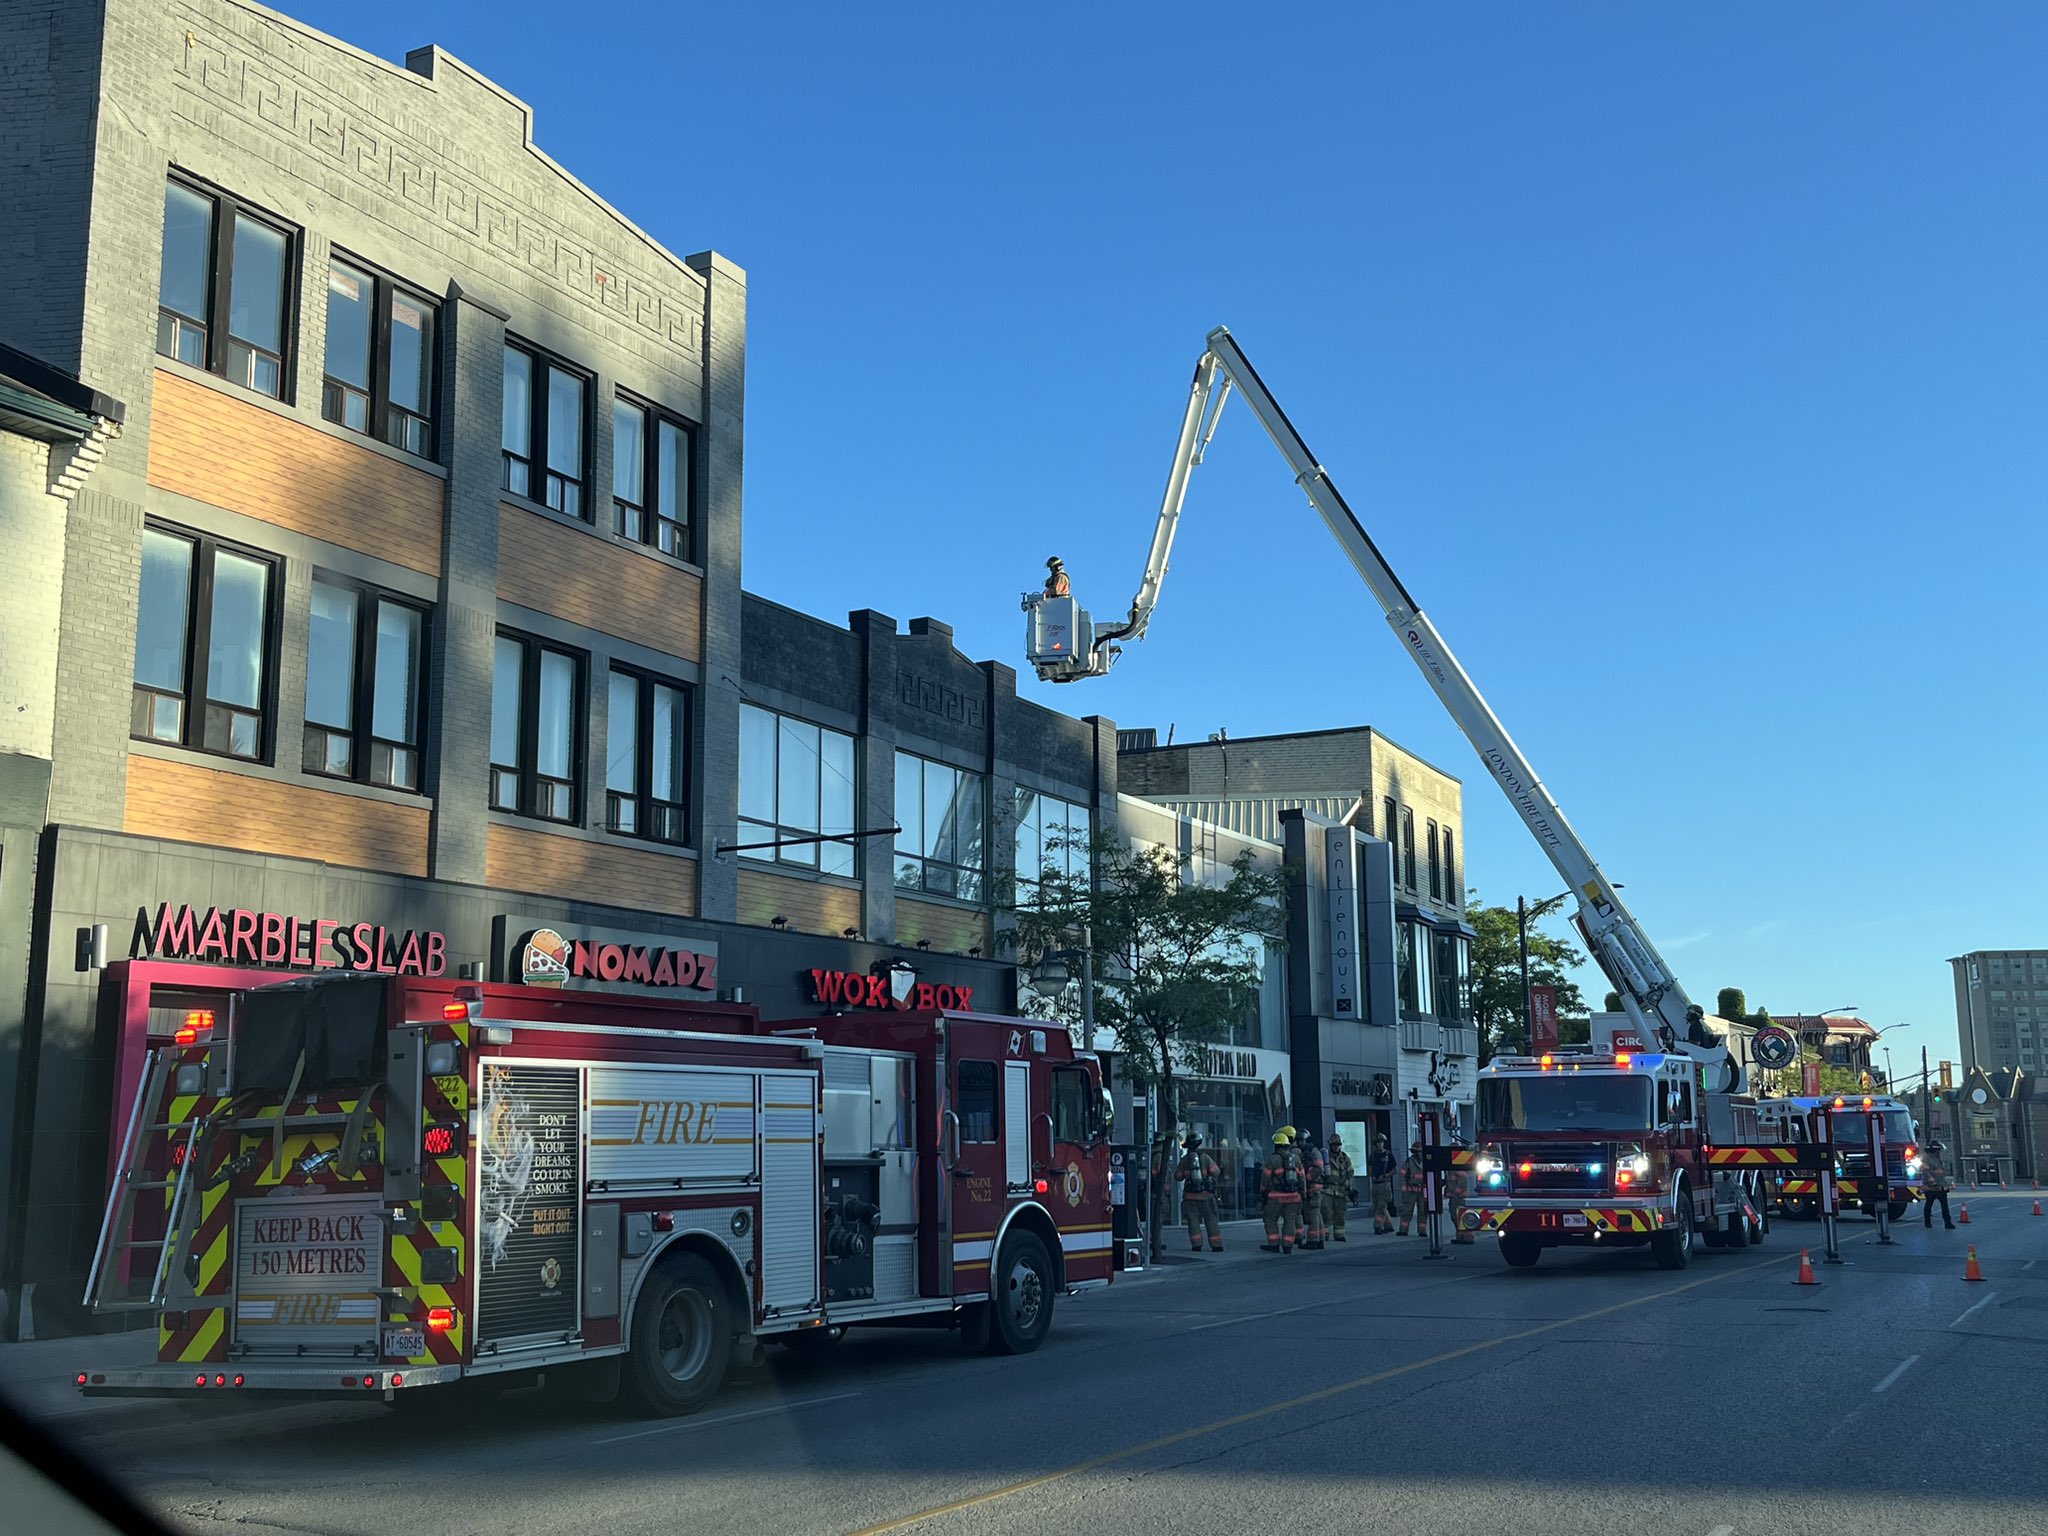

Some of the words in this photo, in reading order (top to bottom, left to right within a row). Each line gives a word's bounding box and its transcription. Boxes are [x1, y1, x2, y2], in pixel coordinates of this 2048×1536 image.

[1486, 748, 1524, 793] LONDON
[1518, 794, 1542, 819] FIRE
[1535, 819, 1562, 849] DEPT.
[153, 901, 339, 967] MARBLE
[353, 921, 447, 977] SLAB
[573, 938, 718, 991] NOMADZ
[811, 968, 889, 1010] WOK
[916, 982, 974, 1012] BOX
[1534, 993, 1544, 1040] RICHMOND
[1541, 994, 1551, 1017] ROW
[1616, 1037, 1643, 1047] CIRC
[545, 1128, 562, 1139] LET
[632, 1101, 718, 1145] FIRE
[539, 1142, 565, 1153] YOUR
[534, 1155, 571, 1167] DREAMS
[532, 1169, 548, 1181] GO
[549, 1169, 561, 1181] UP
[561, 1168, 572, 1180] IN
[966, 1177, 991, 1189] ENGINE
[533, 1209, 547, 1221] PUT
[547, 1209, 556, 1220] IT
[1537, 1213, 1557, 1227] T1
[253, 1217, 302, 1244] KEEP
[306, 1215, 365, 1243] BACK
[532, 1223, 555, 1235] RIGHT
[251, 1250, 282, 1275] 150
[286, 1247, 366, 1275] METRES
[271, 1293, 344, 1326] FIRE
